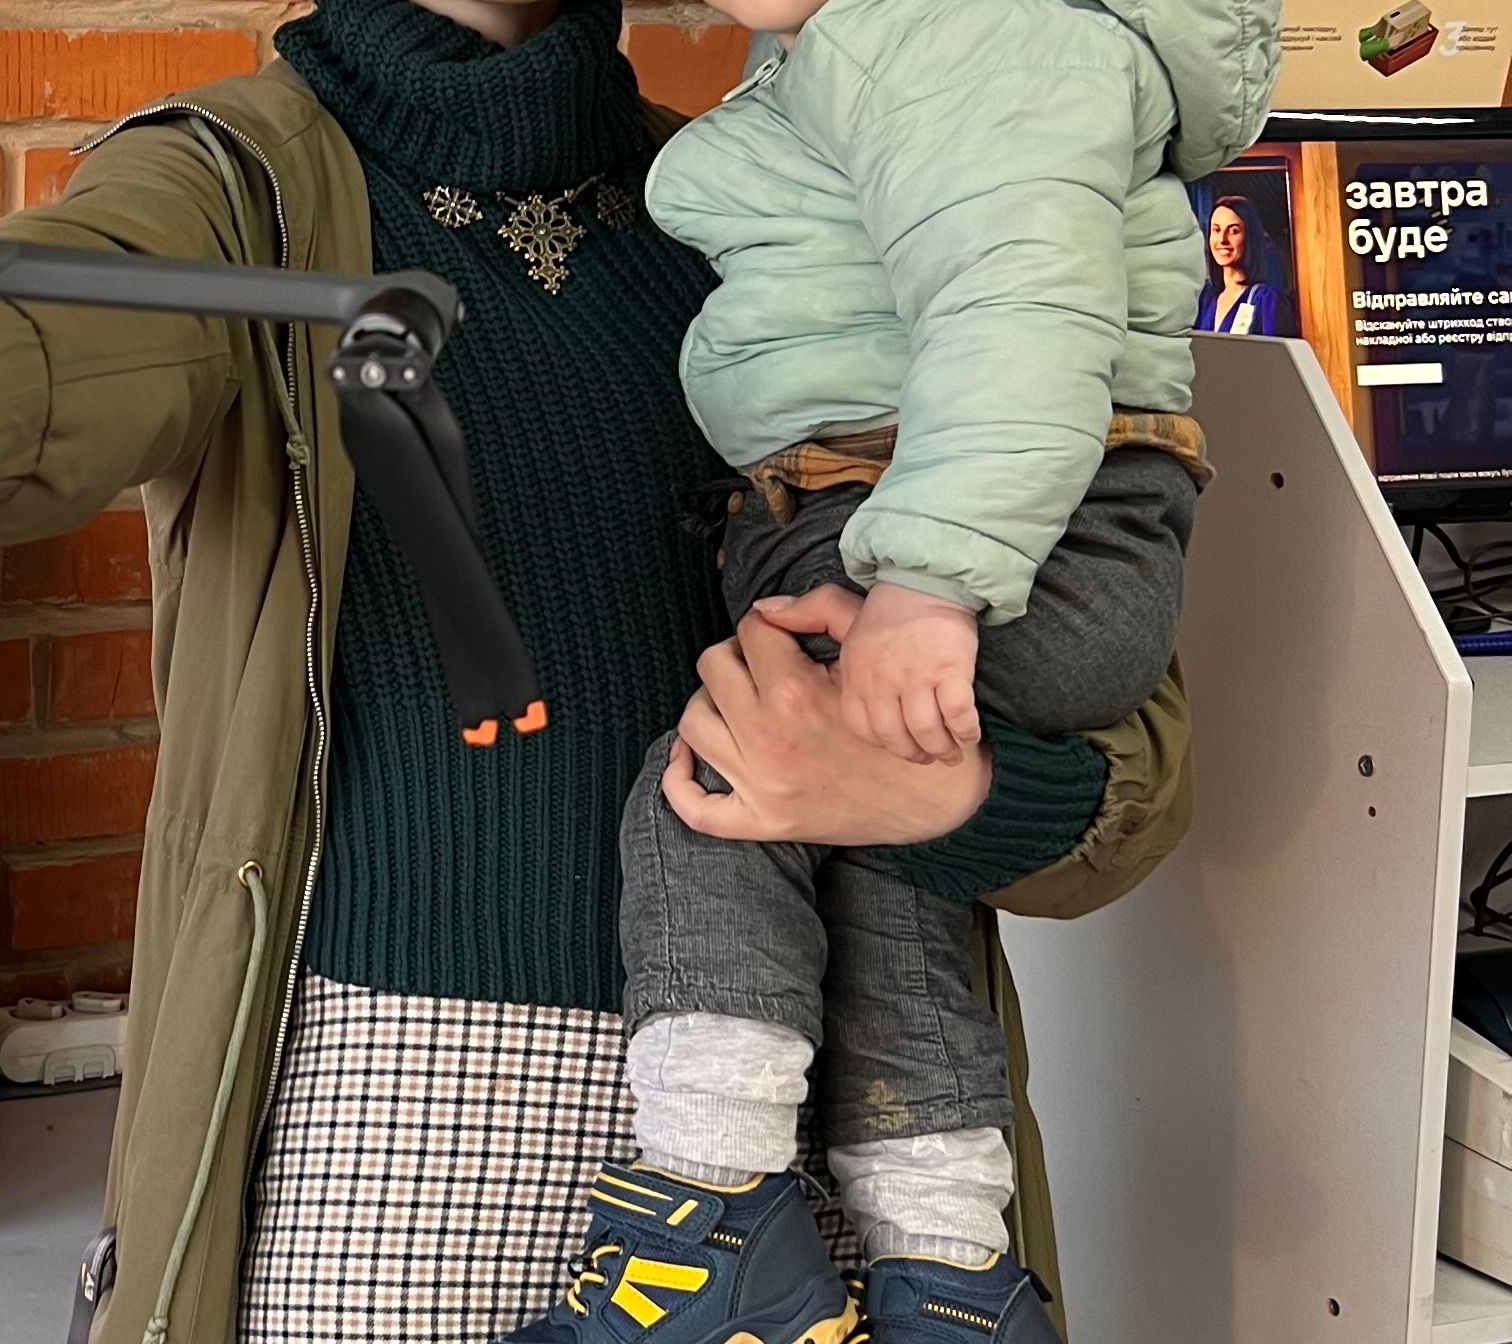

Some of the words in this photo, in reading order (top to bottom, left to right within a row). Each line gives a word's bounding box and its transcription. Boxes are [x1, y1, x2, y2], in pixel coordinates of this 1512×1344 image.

[1346, 180, 1488, 215] завтра
[1349, 219, 1448, 262] буде
[1352, 288, 1483, 310] Відправляйте
[1355, 319, 1425, 332] Відскануйте
[1415, 333, 1436, 344] або
